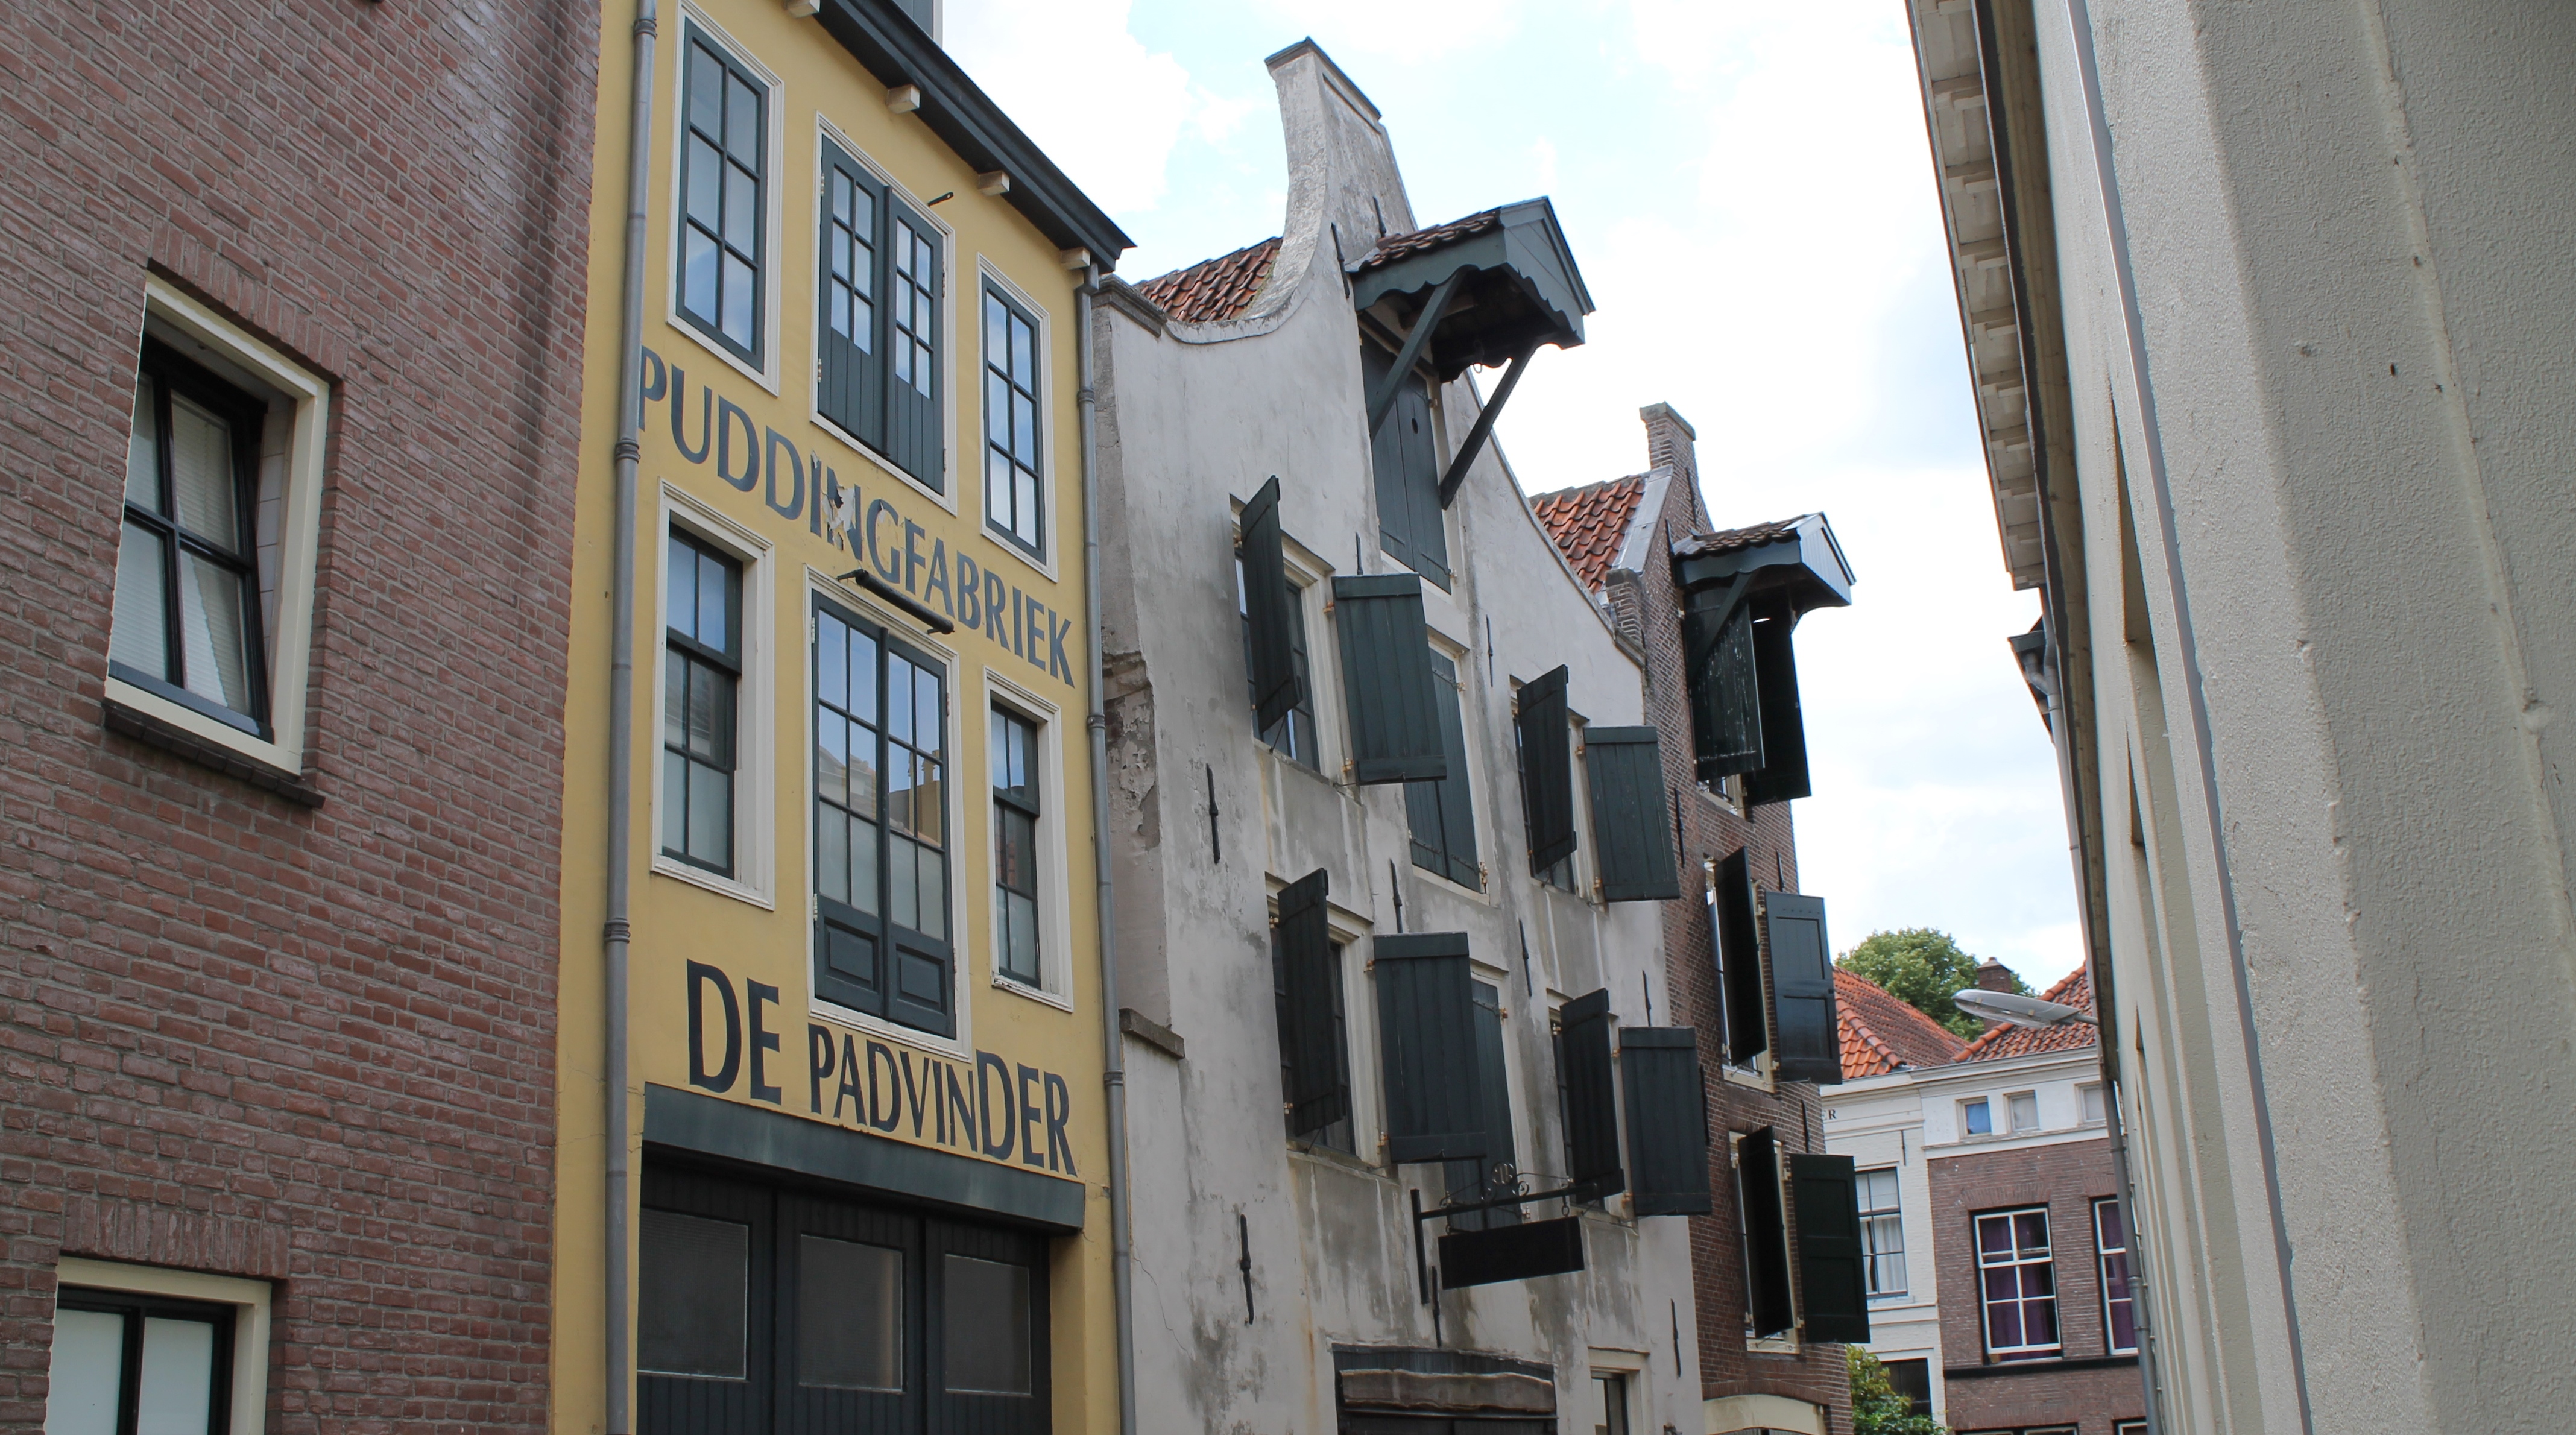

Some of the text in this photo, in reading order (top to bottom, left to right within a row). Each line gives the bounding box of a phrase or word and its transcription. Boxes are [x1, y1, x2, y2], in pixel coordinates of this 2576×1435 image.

[638, 345, 1075, 689] PUDDINGFABRIEK
[687, 959, 1077, 1178] DE PADVINDER
